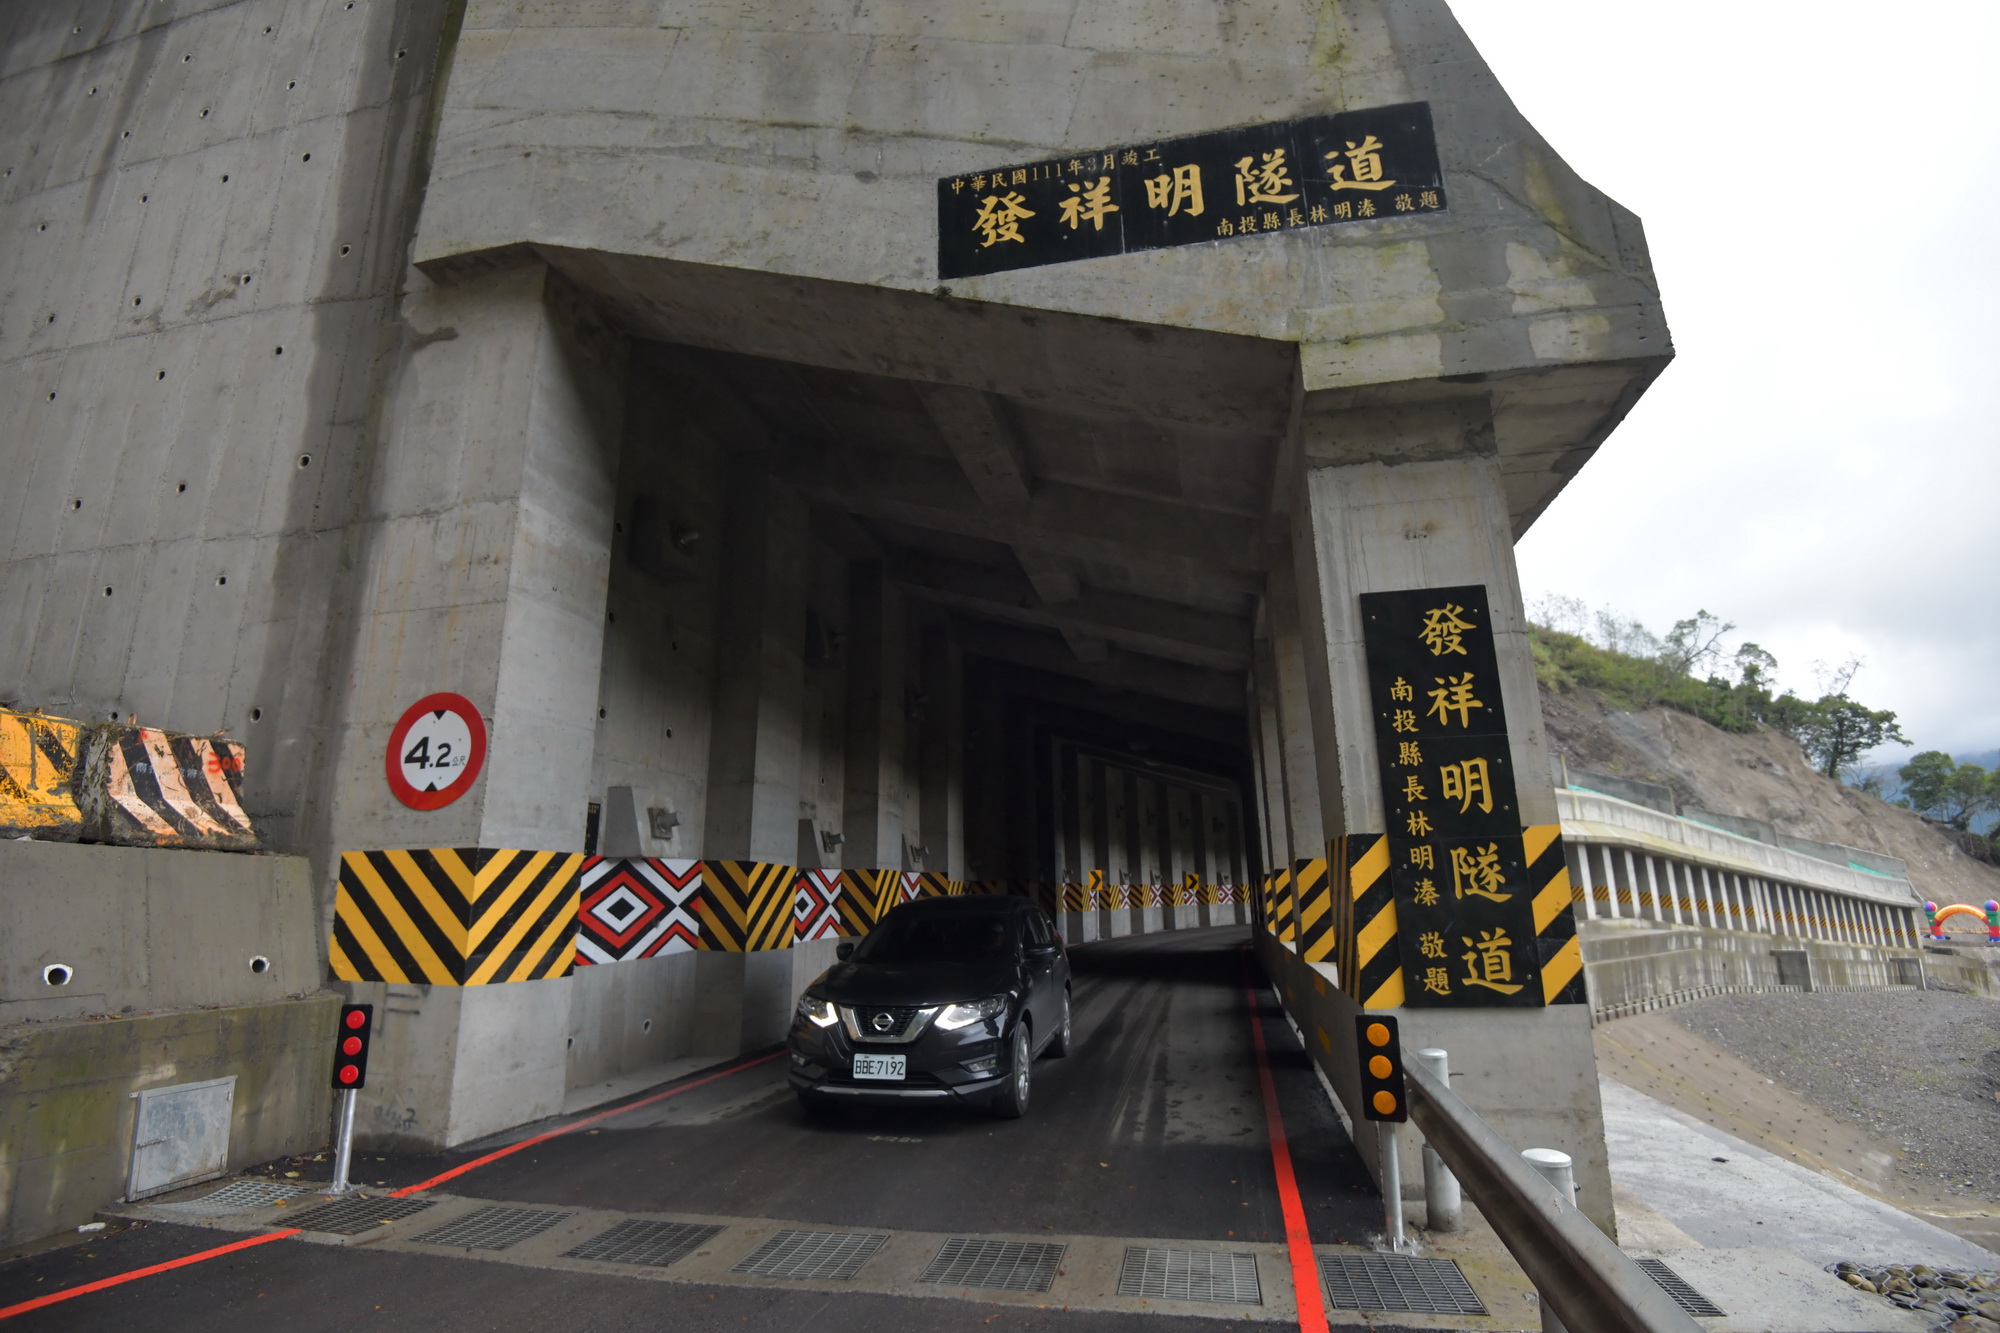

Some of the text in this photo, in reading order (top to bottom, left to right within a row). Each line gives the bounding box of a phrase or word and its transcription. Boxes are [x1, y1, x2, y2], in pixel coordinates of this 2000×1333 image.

[951, 148, 1161, 195] 中華民國111年3月竣工
[971, 135, 1397, 248] 發祥明隧道
[208, 752, 241, 773] 300
[1418, 603, 1524, 995] 發祥明隧道
[1390, 676, 1452, 996] 南投縣長林明溱 敬題
[855, 1060, 904, 1075] BBE-7192
